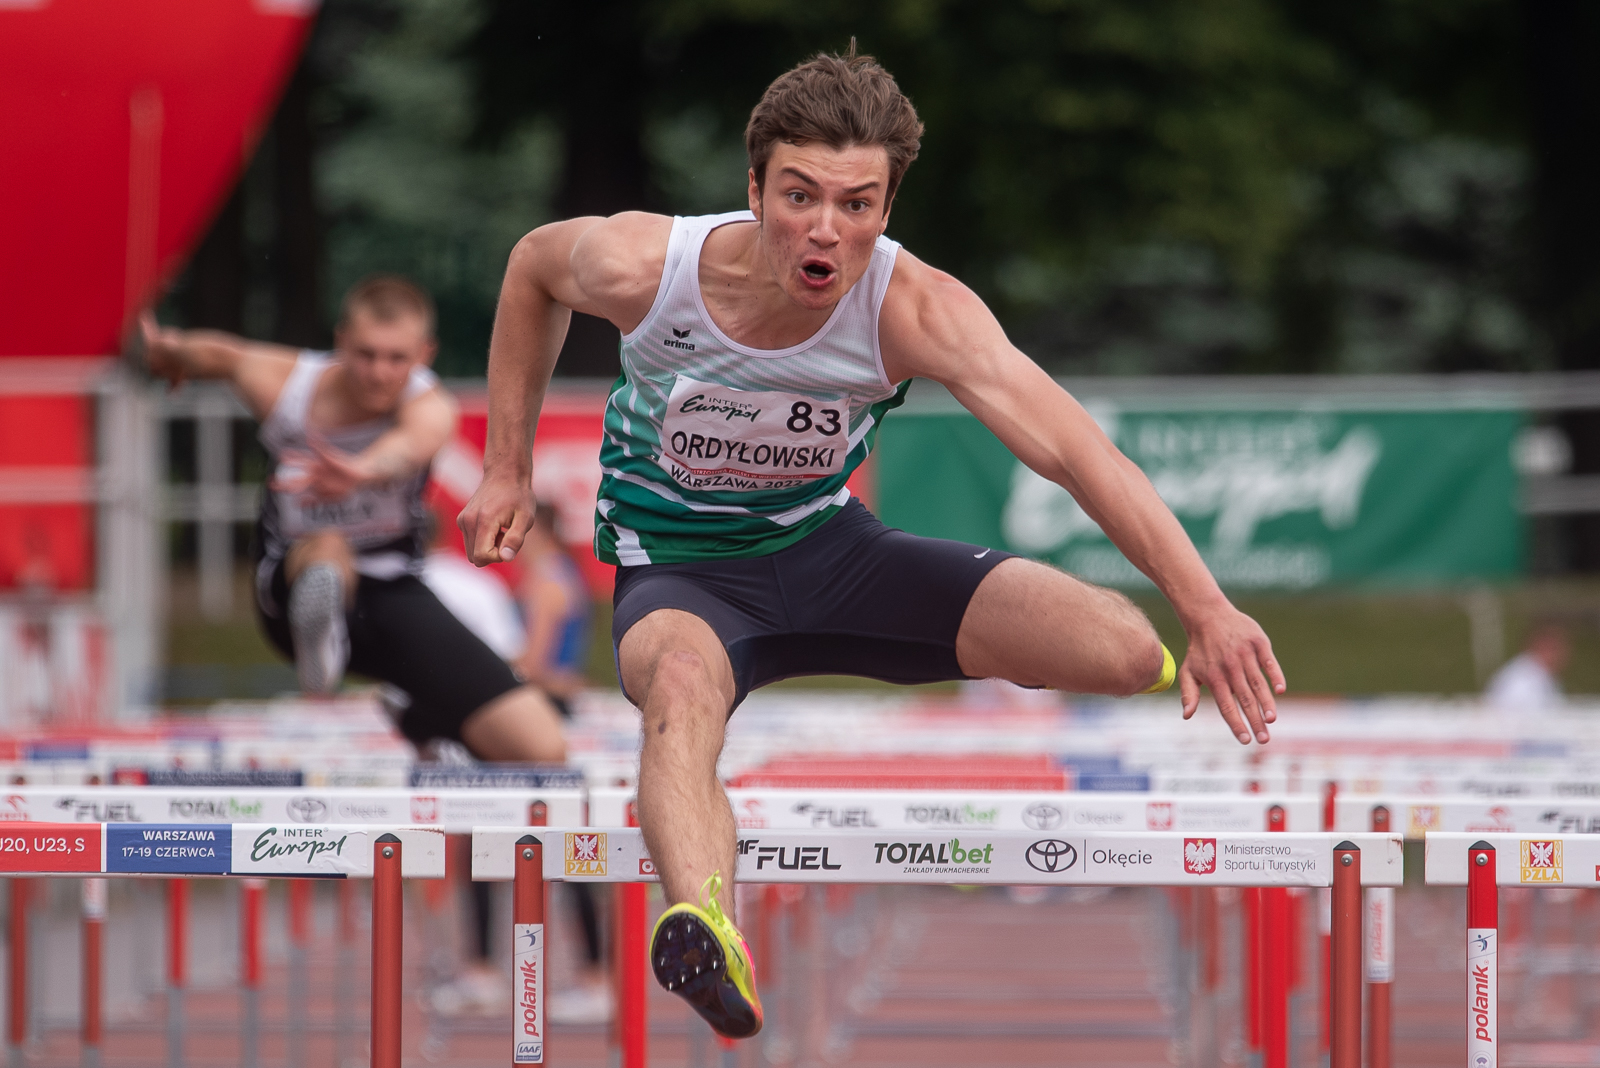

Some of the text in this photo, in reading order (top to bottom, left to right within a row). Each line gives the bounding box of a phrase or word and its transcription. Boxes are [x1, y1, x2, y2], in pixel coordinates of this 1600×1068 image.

[663, 338, 696, 352] erima
[679, 394, 762, 423] Europol
[708, 397, 748, 410] INTER
[786, 401, 842, 436] 83
[670, 430, 836, 468] ORDYŁOWSKI
[671, 464, 803, 489] WARSZAWA 2022
[74, 801, 142, 821] FUEL
[812, 806, 877, 828] FUEL
[142, 830, 215, 841] WARSZAWA
[283, 828, 323, 837] INTER
[34, 837, 71, 854] U23,
[75, 837, 86, 851] S
[122, 847, 215, 858] 17-19 CZERWCA
[250, 827, 347, 863] Europol
[873, 838, 994, 865] TOTALbet
[1224, 844, 1291, 855] Ministerstwo
[757, 846, 842, 870] FUEL
[1092, 849, 1153, 867] Okęcie
[1224, 859, 1317, 871] Sportu i Turystyki
[566, 862, 605, 874] PZLA
[1522, 869, 1561, 881] PZLA
[520, 959, 540, 1037] polanik
[1472, 964, 1492, 1042] polanik
[519, 1045, 541, 1054] IAAF
